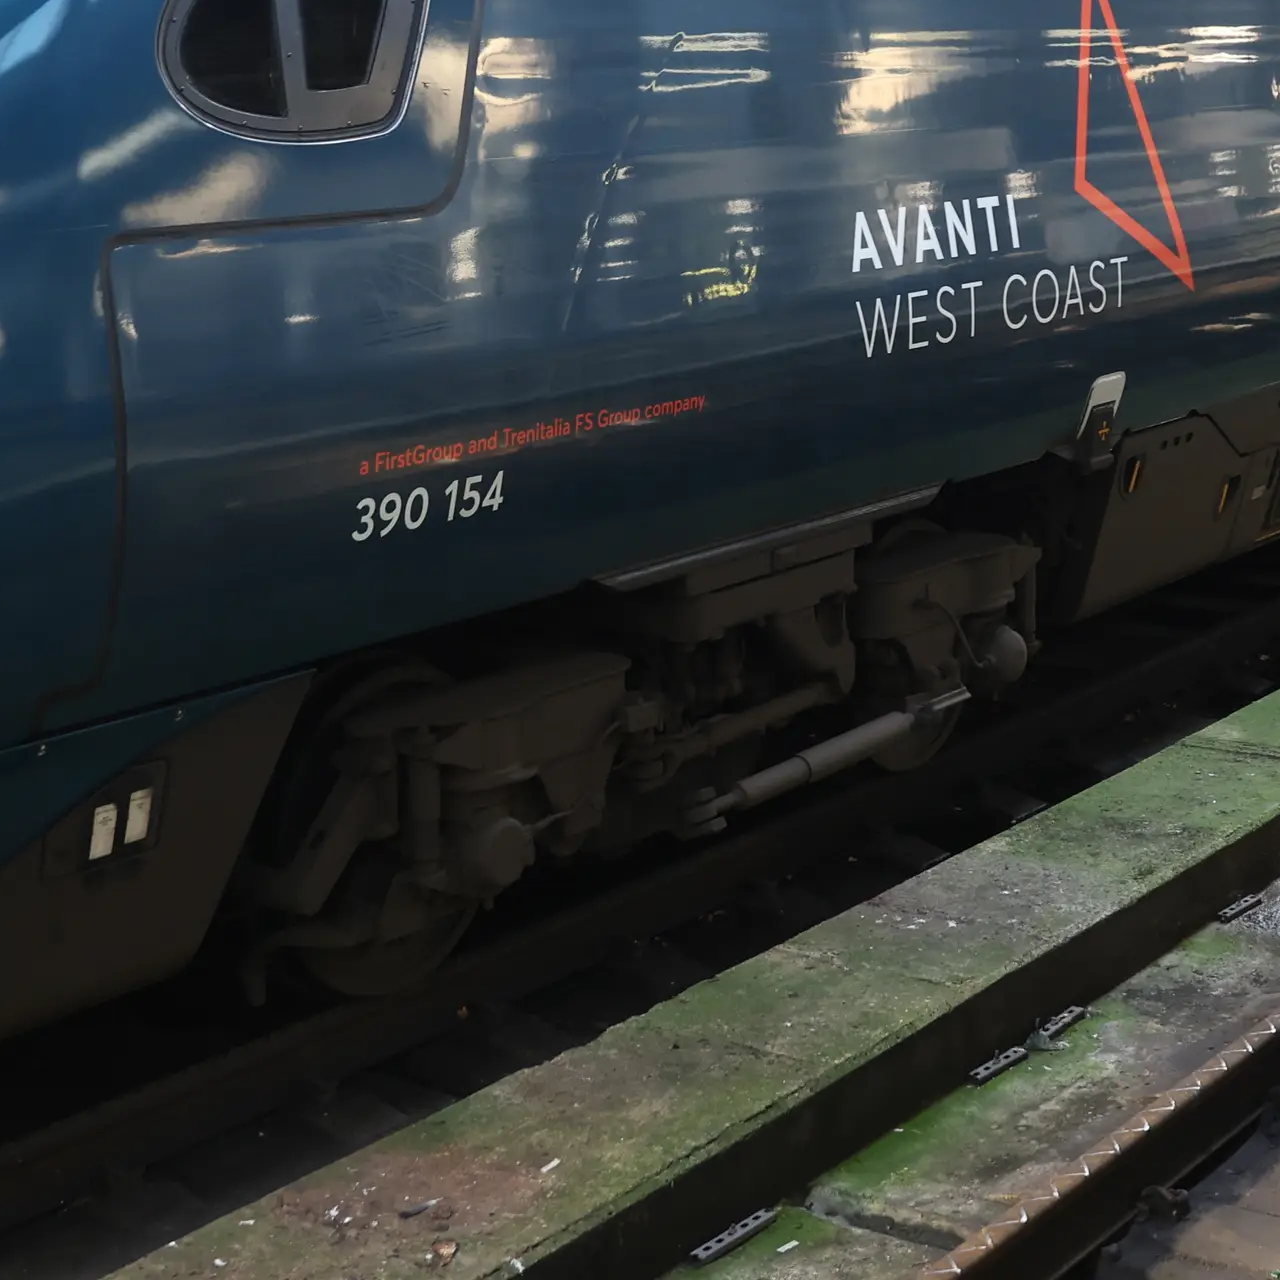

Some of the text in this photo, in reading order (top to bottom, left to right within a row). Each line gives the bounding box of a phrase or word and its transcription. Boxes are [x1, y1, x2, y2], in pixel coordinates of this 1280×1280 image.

[852, 194, 1020, 272] AVANTI
[856, 256, 1128, 357] WEST COAST
[359, 394, 706, 475] a FirstGroup and Trenitalia FS Group company
[351, 470, 504, 542] 390 154
